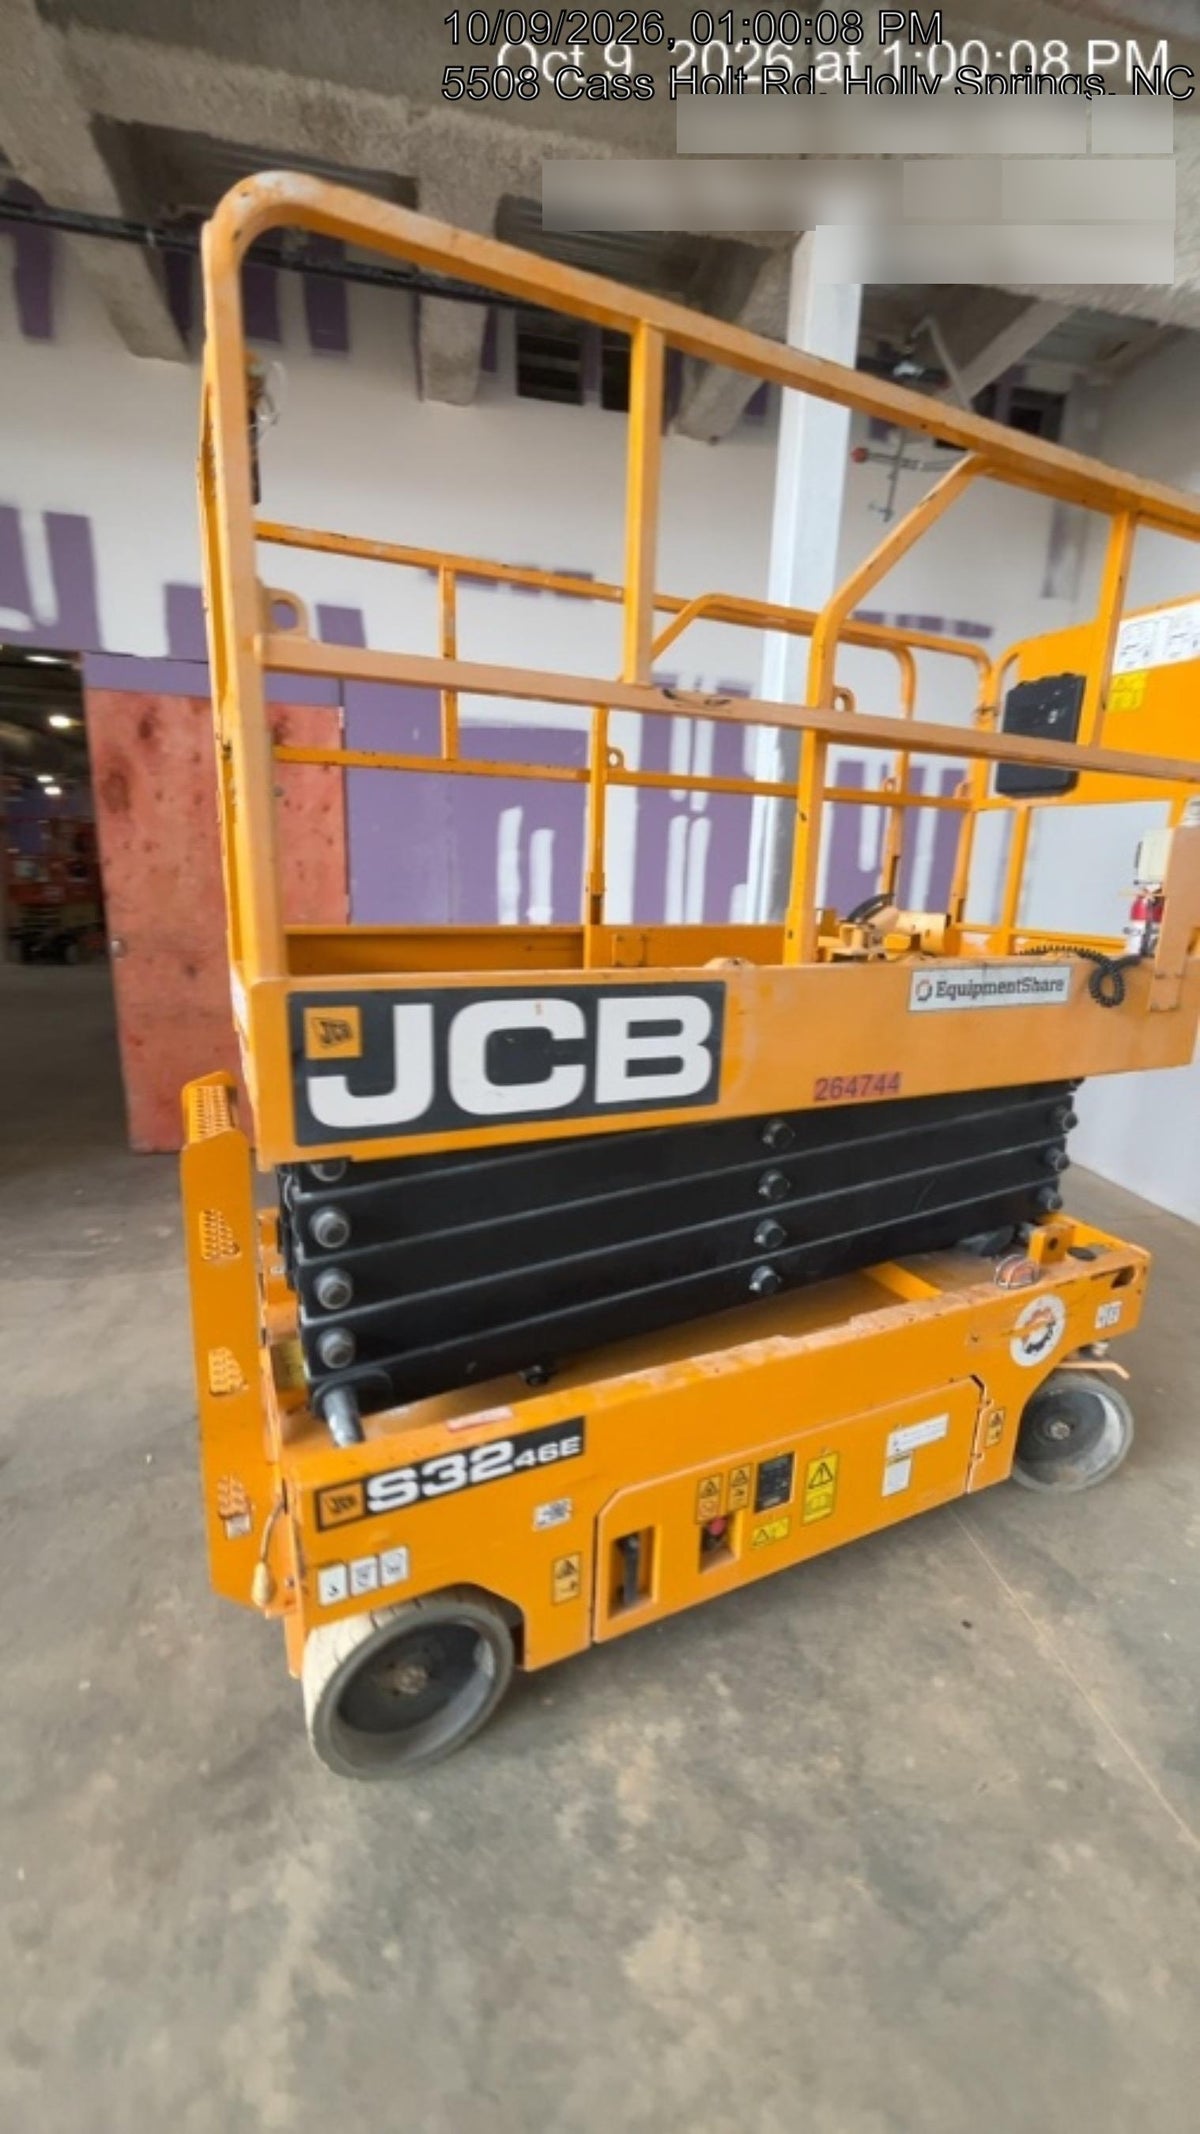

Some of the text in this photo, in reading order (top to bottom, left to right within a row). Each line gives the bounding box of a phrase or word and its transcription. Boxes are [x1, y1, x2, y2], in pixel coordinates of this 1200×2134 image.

[936, 976, 1065, 1000] EquipmentShare
[307, 995, 713, 1127] JCB
[814, 1072, 903, 1101] 264744
